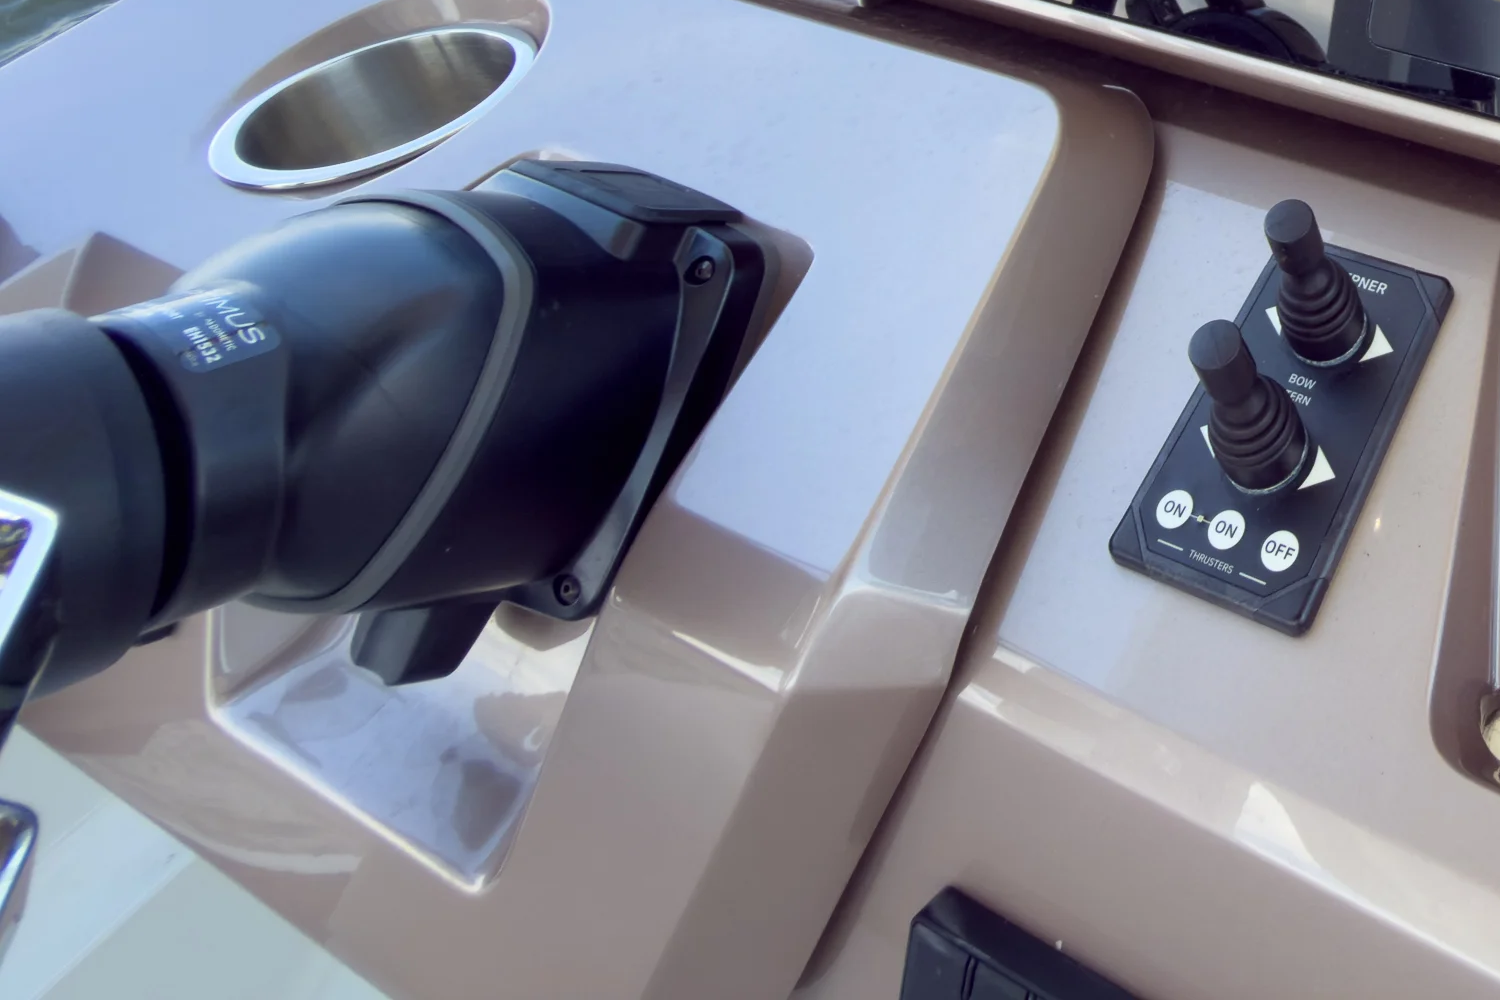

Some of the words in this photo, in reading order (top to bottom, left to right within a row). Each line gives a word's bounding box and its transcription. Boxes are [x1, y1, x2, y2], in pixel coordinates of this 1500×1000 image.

[1288, 373, 1317, 390] BOW
[1163, 499, 1187, 518] ON
[1214, 520, 1238, 538] ON
[1264, 540, 1295, 561] OFF
[1188, 549, 1234, 575] THRUSTERS
